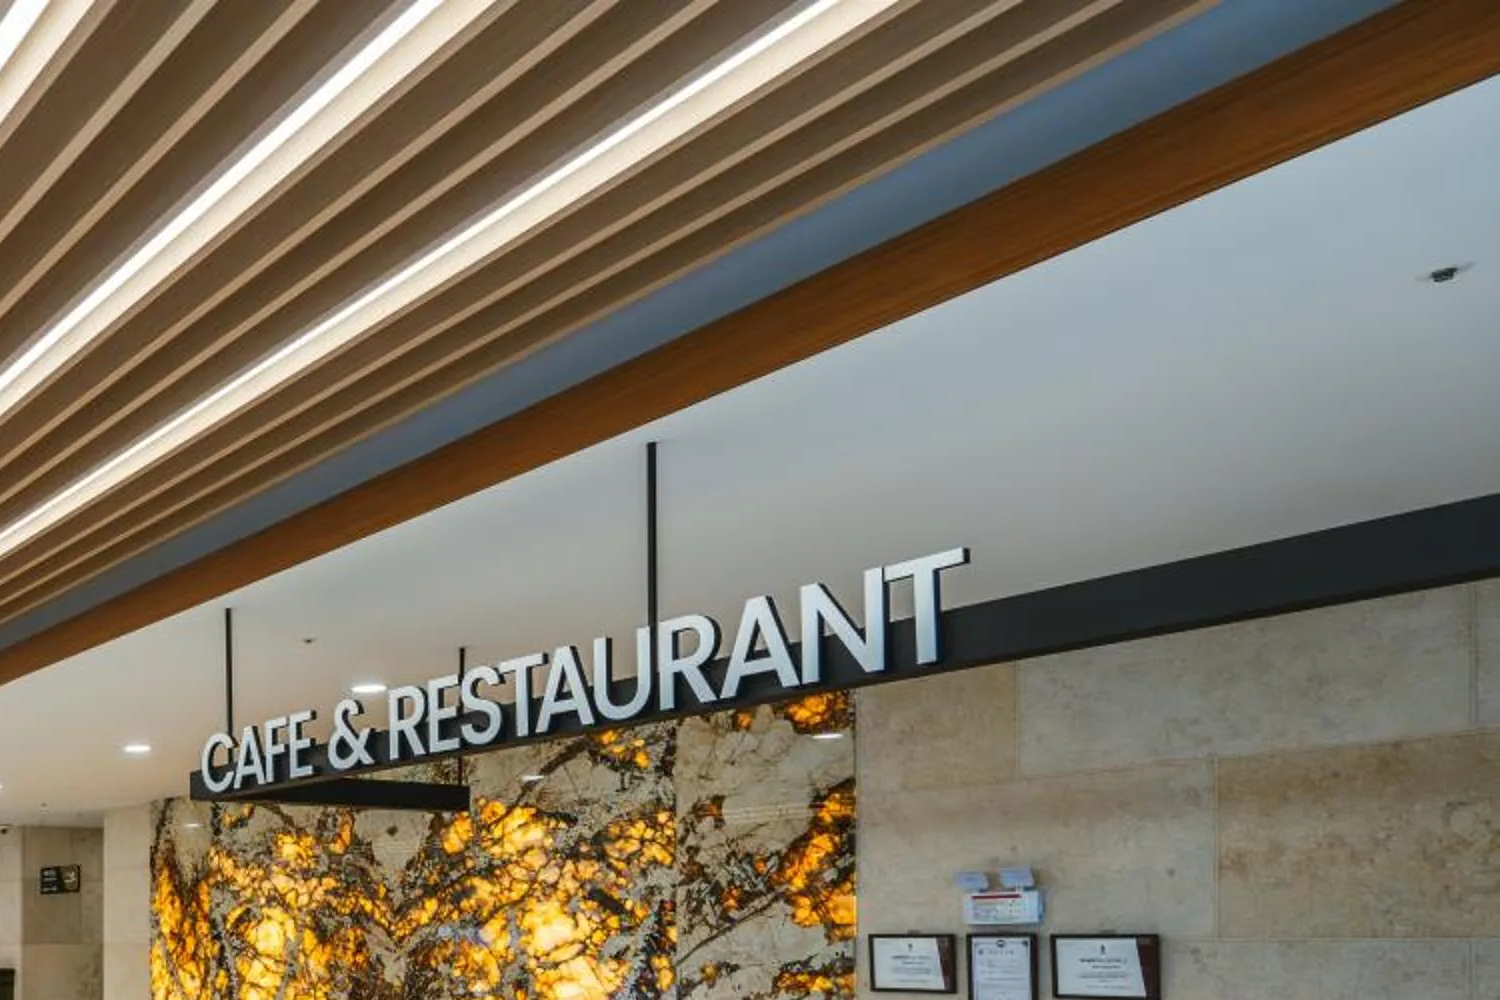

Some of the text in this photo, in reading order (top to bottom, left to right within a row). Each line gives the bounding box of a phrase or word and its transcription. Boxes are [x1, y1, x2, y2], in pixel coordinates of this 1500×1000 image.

[201, 547, 970, 793] CAFE & RESTAURANT
